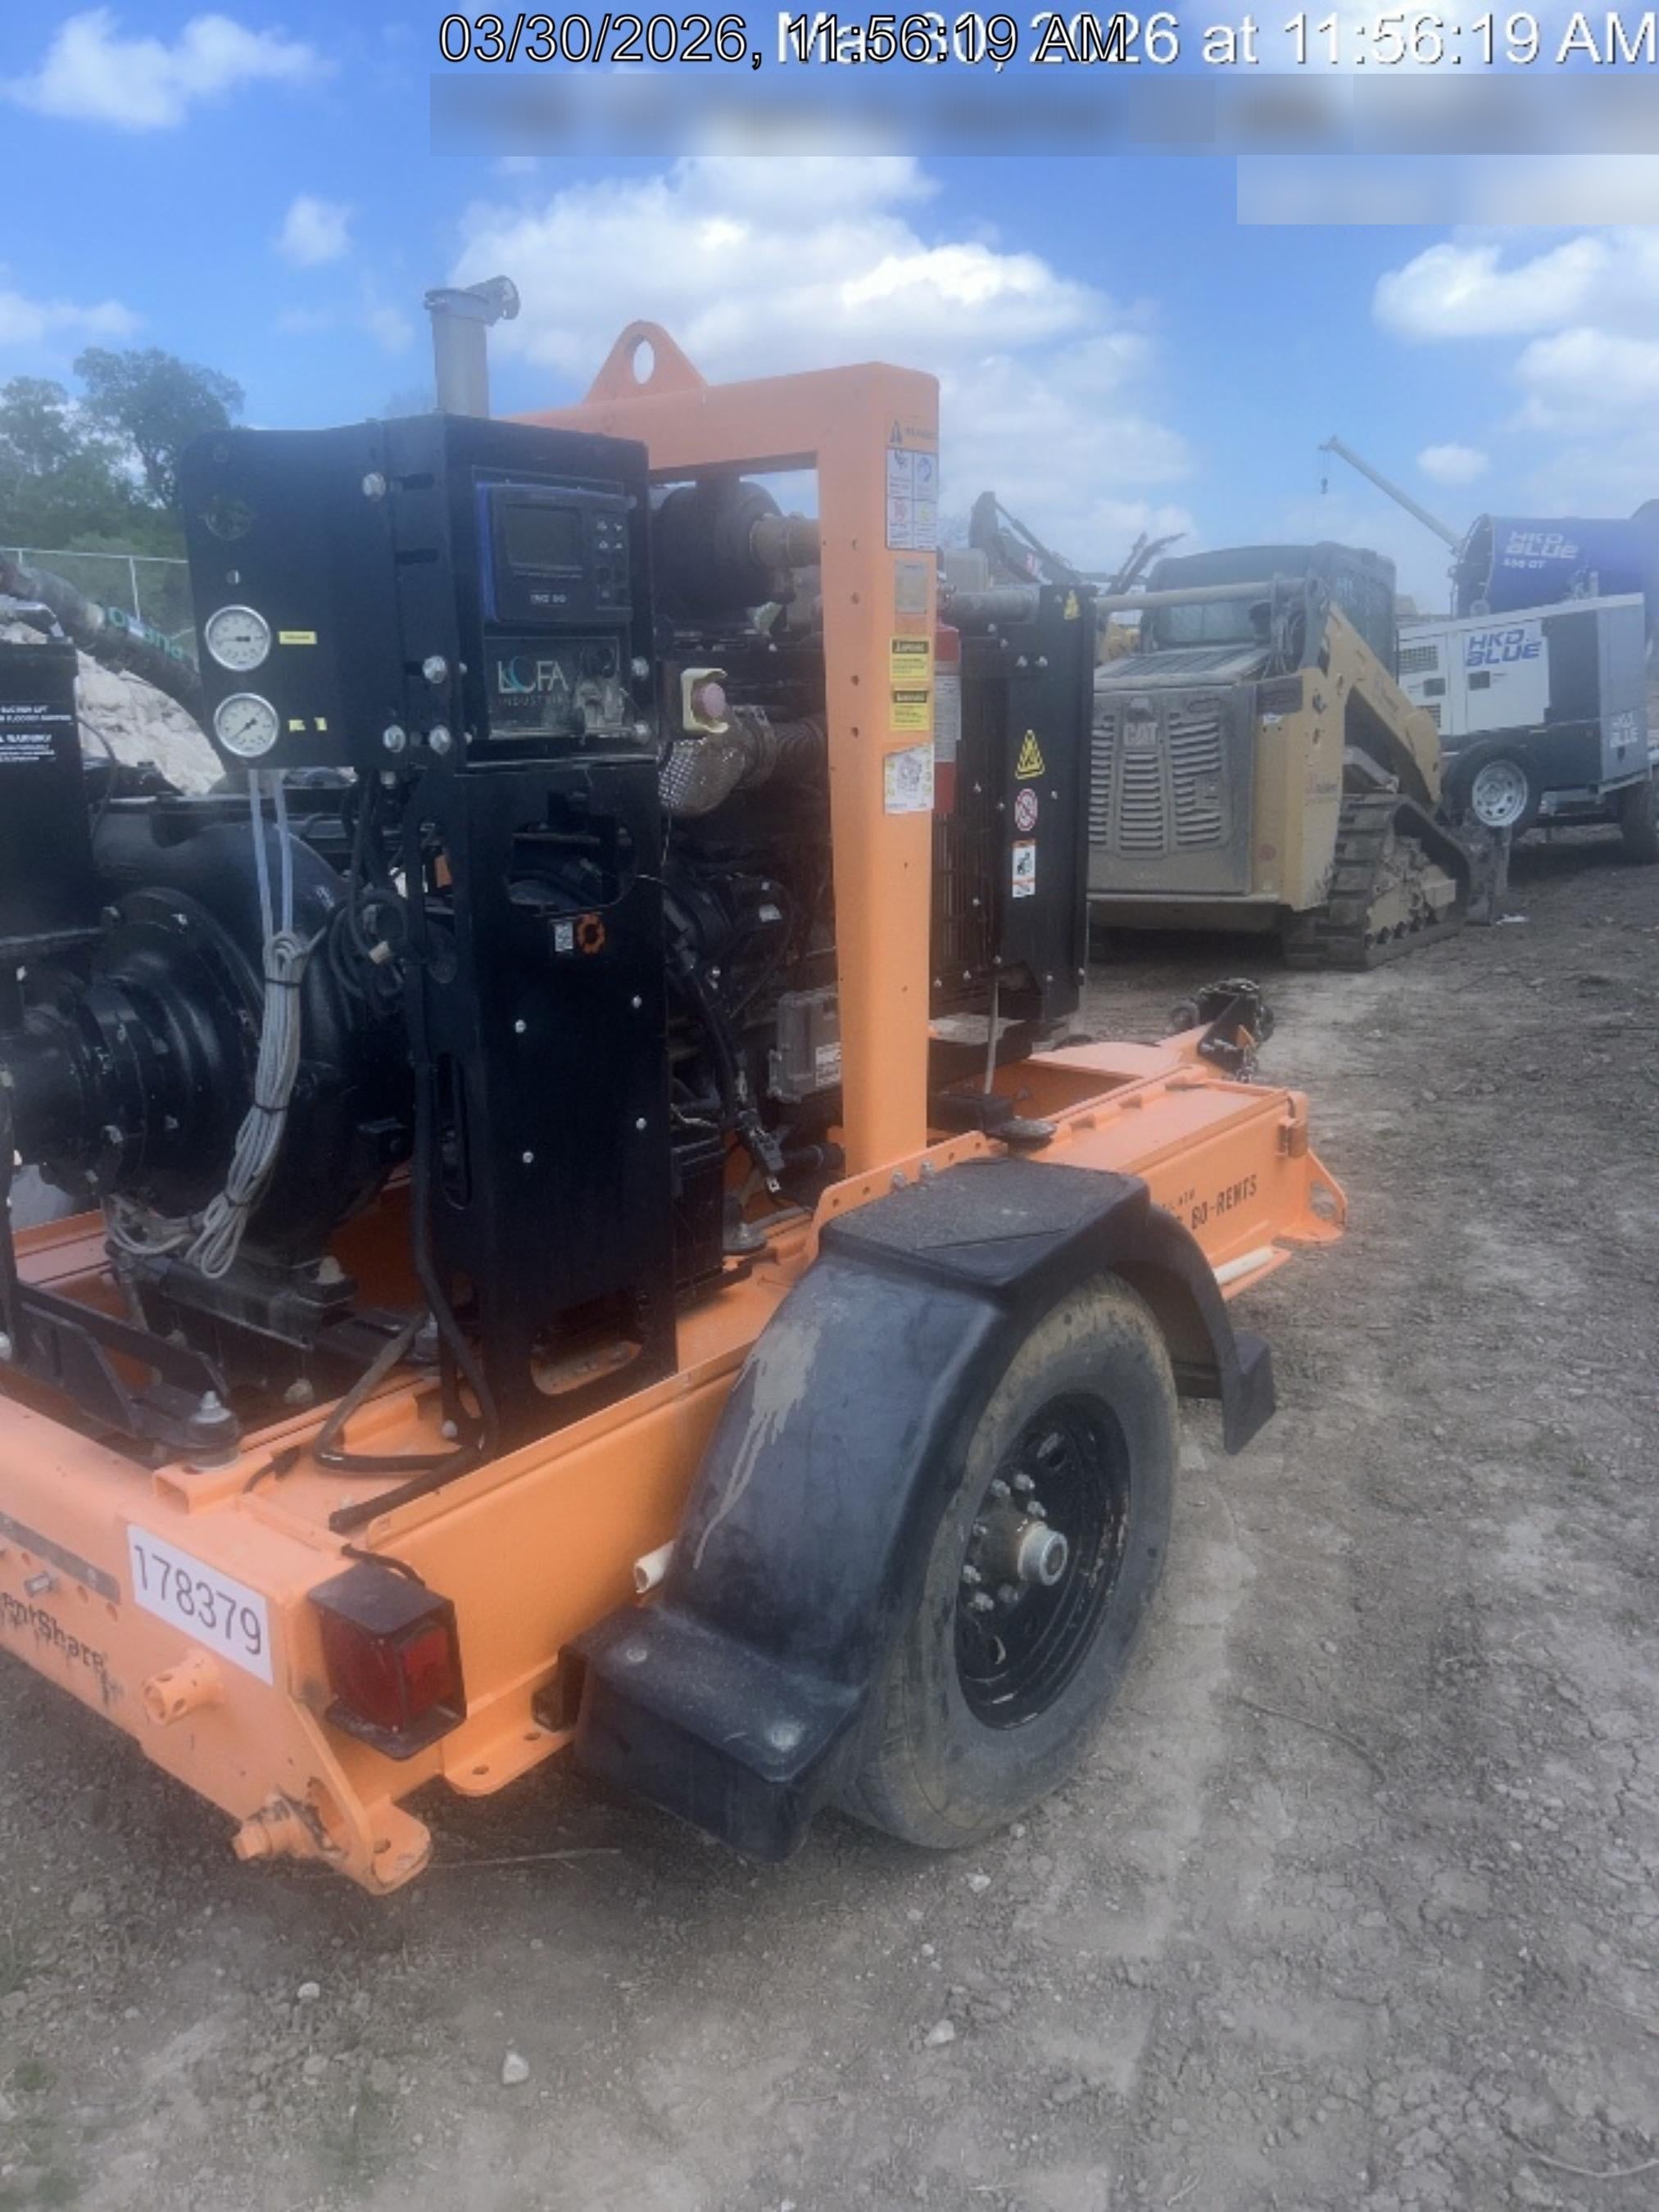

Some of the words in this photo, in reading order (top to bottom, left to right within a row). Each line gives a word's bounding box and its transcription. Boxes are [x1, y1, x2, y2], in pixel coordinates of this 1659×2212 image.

[1508, 530, 1564, 544] HKD
[1504, 542, 1580, 560] BLUE
[1465, 641, 1543, 667] BLUE
[498, 655, 569, 695] LOFA
[1123, 722, 1158, 747] CAT
[134, 1544, 261, 1656] 178379
